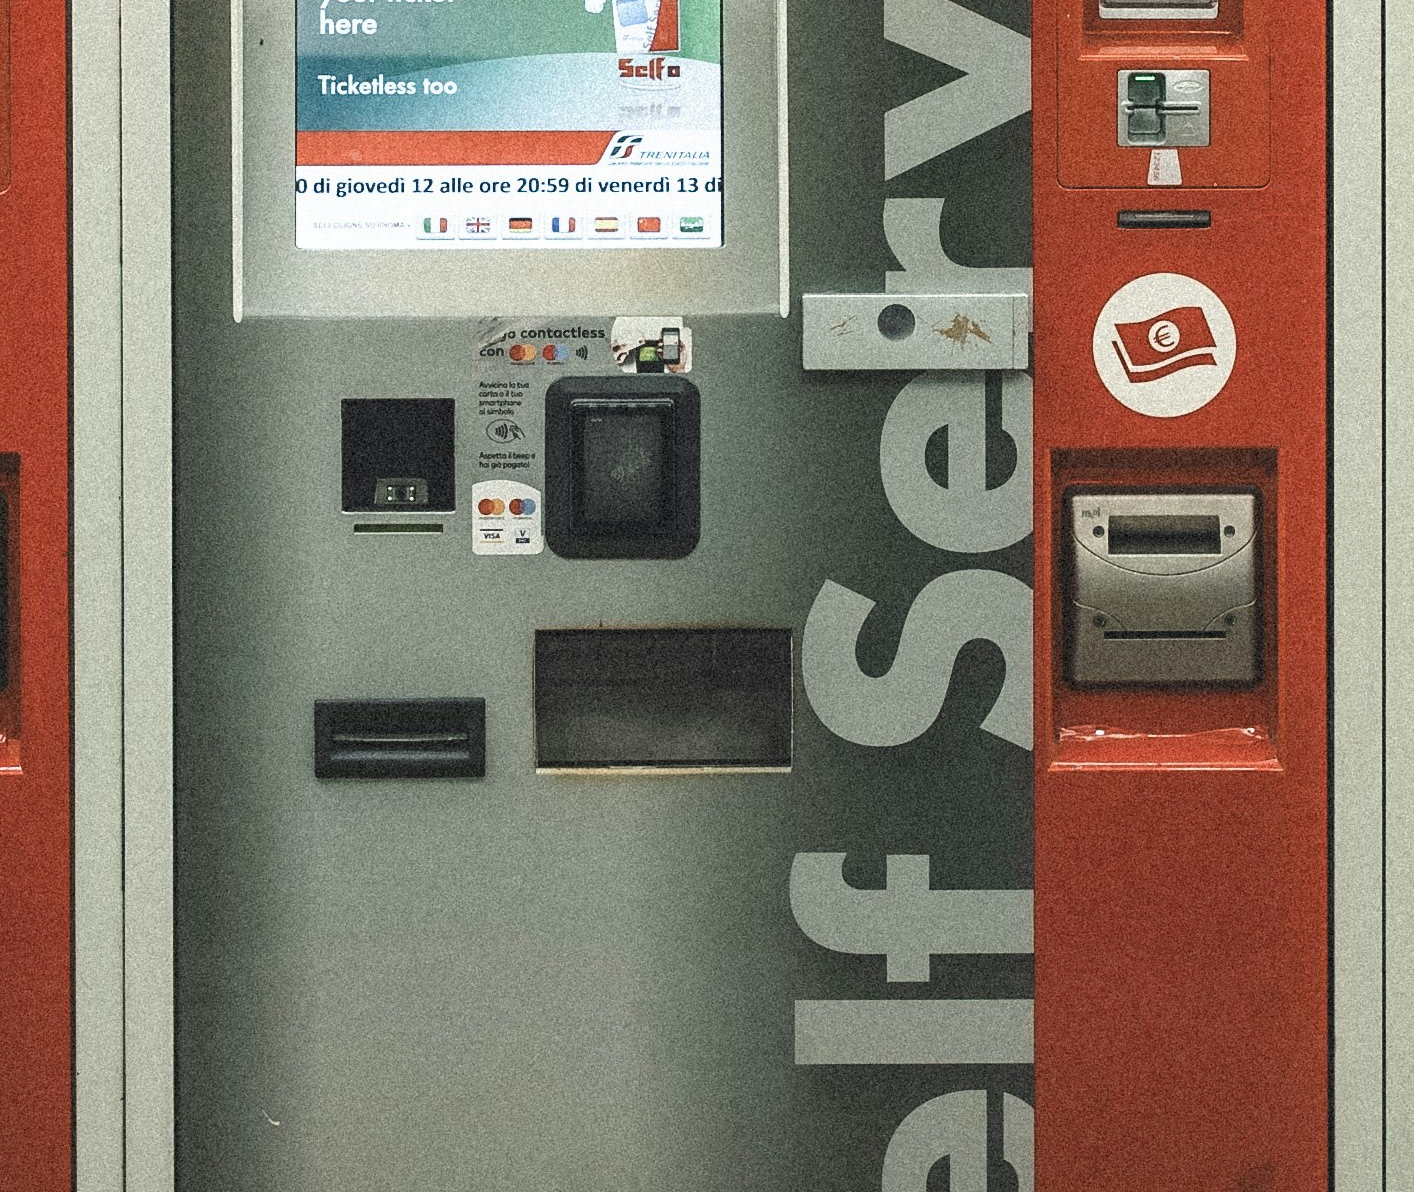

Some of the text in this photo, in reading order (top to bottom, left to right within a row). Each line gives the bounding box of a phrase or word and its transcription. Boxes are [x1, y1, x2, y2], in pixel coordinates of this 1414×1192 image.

[319, 10, 378, 35] here
[318, 74, 458, 96] Ticketless too
[640, 150, 710, 159] TRENITALIA
[313, 176, 331, 194] di
[335, 176, 405, 198] giovedì
[413, 179, 434, 194] 12
[439, 176, 474, 194] alle
[480, 181, 510, 194] ore
[517, 178, 570, 194] 20:59
[575, 176, 593, 194] di
[598, 176, 670, 194] venerdì
[677, 178, 699, 194] 13
[520, 325, 606, 340] contactless
[479, 347, 505, 357] con
